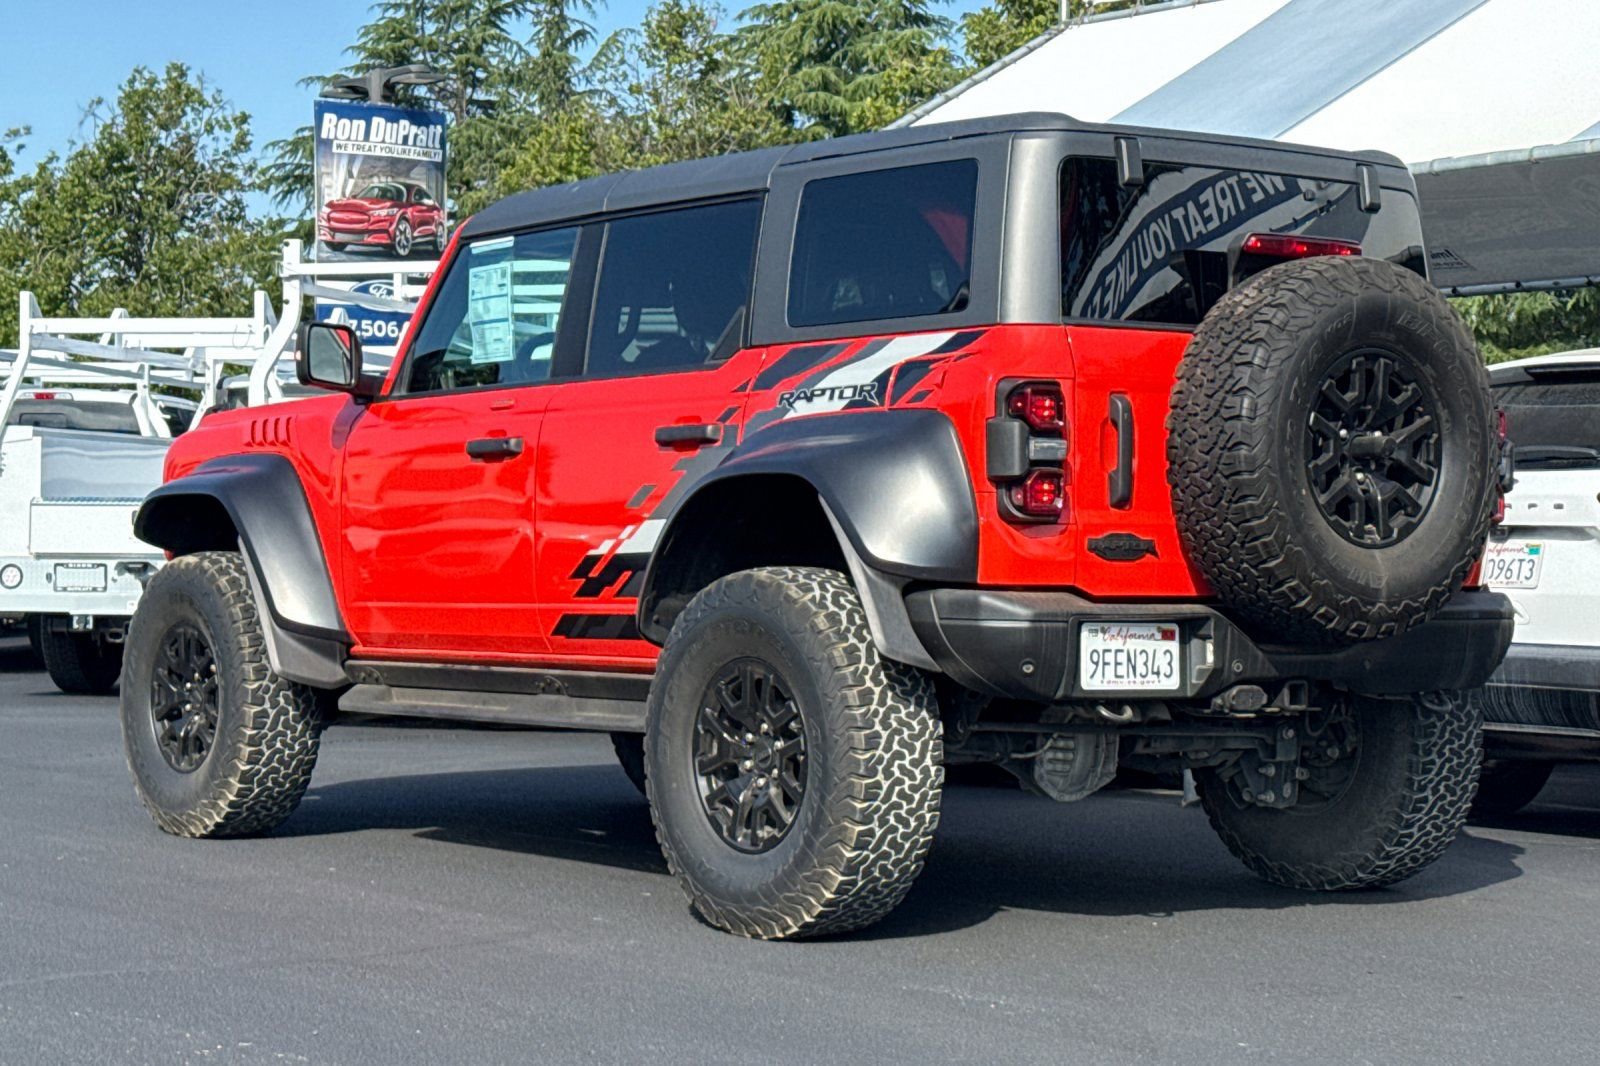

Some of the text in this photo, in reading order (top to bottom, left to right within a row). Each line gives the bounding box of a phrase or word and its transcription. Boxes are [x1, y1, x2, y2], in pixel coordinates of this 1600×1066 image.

[320, 112, 443, 149] Ron DuPratt
[335, 142, 441, 160] WE TREAT YOU LIKE FAMILY!
[777, 383, 879, 413] RAPTOR
[1488, 544, 1528, 556] alifornia
[1102, 626, 1161, 646] California
[1089, 648, 1174, 680] 9FEN343
